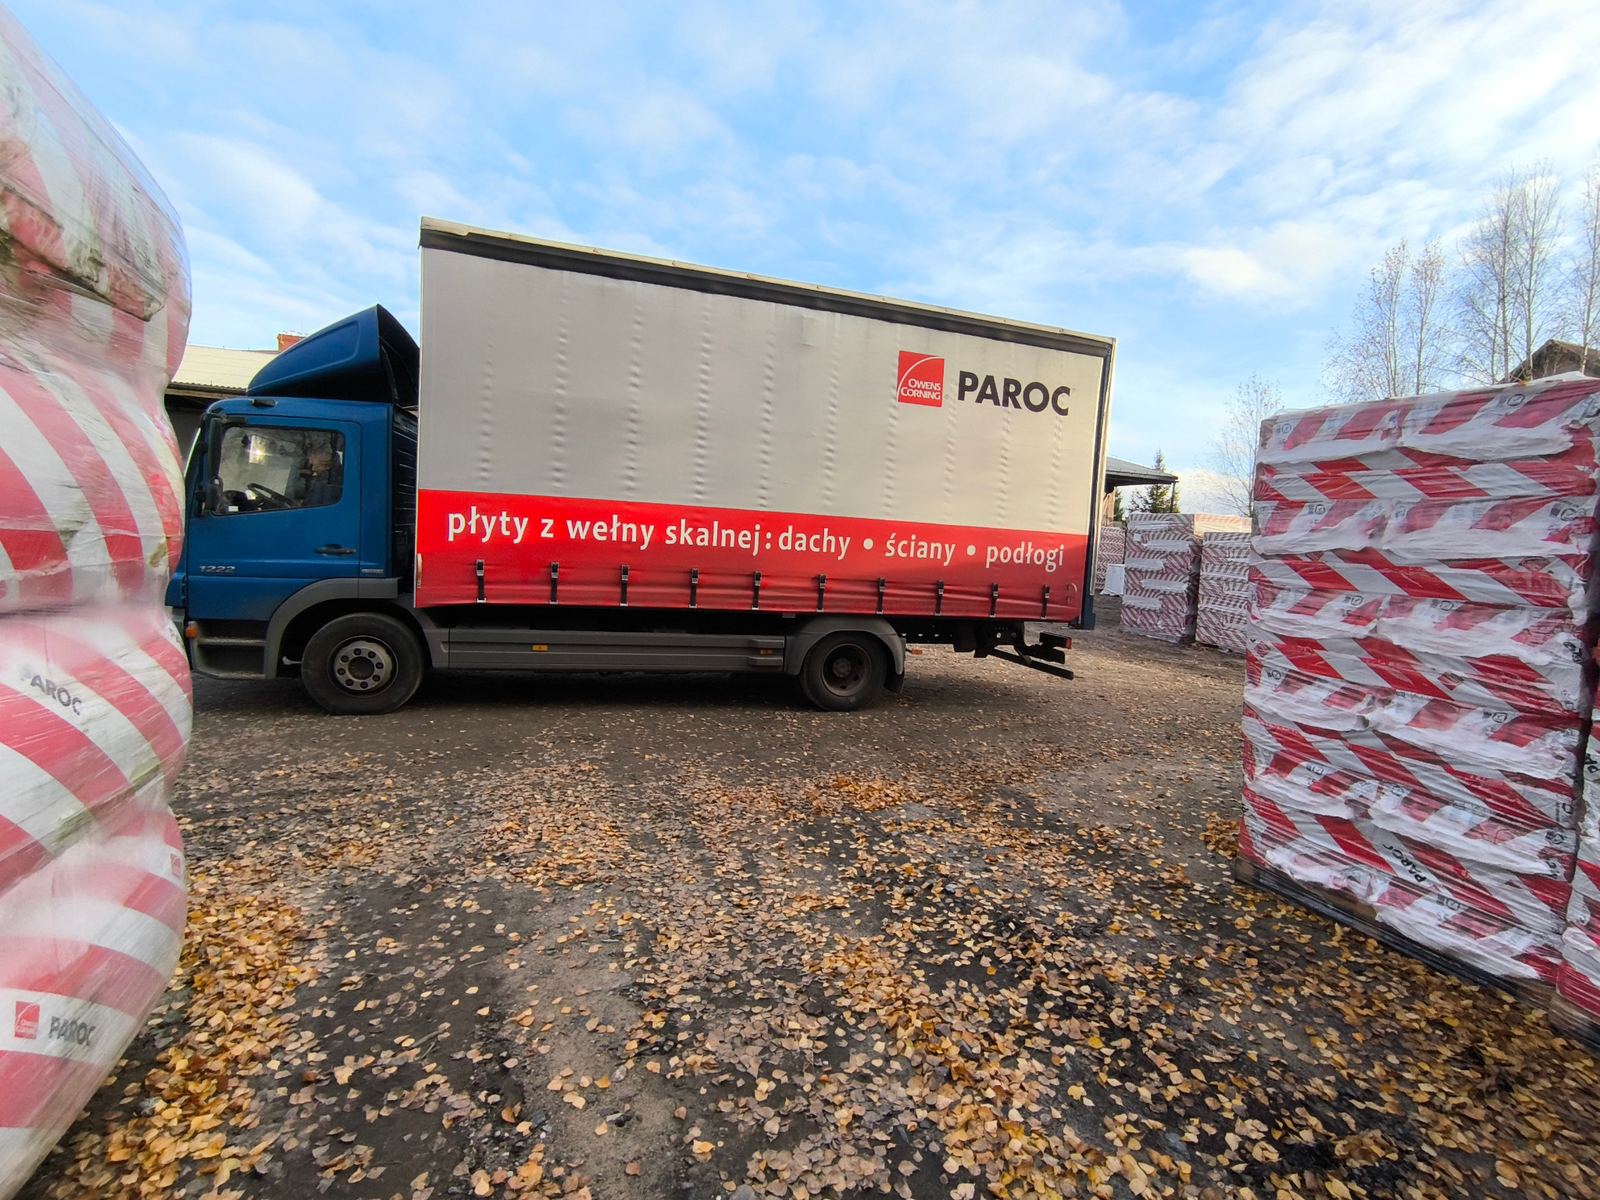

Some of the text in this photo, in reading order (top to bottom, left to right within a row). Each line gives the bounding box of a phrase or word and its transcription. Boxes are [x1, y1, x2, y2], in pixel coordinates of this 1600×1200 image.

[900, 387, 941, 400] CORNING
[908, 378, 941, 391] OWENS
[957, 370, 1071, 416] PAROC
[447, 506, 529, 543] płyty
[540, 518, 555, 538] z
[566, 515, 655, 550] wełny
[885, 533, 955, 566] ściany
[985, 541, 1065, 573] podłogi
